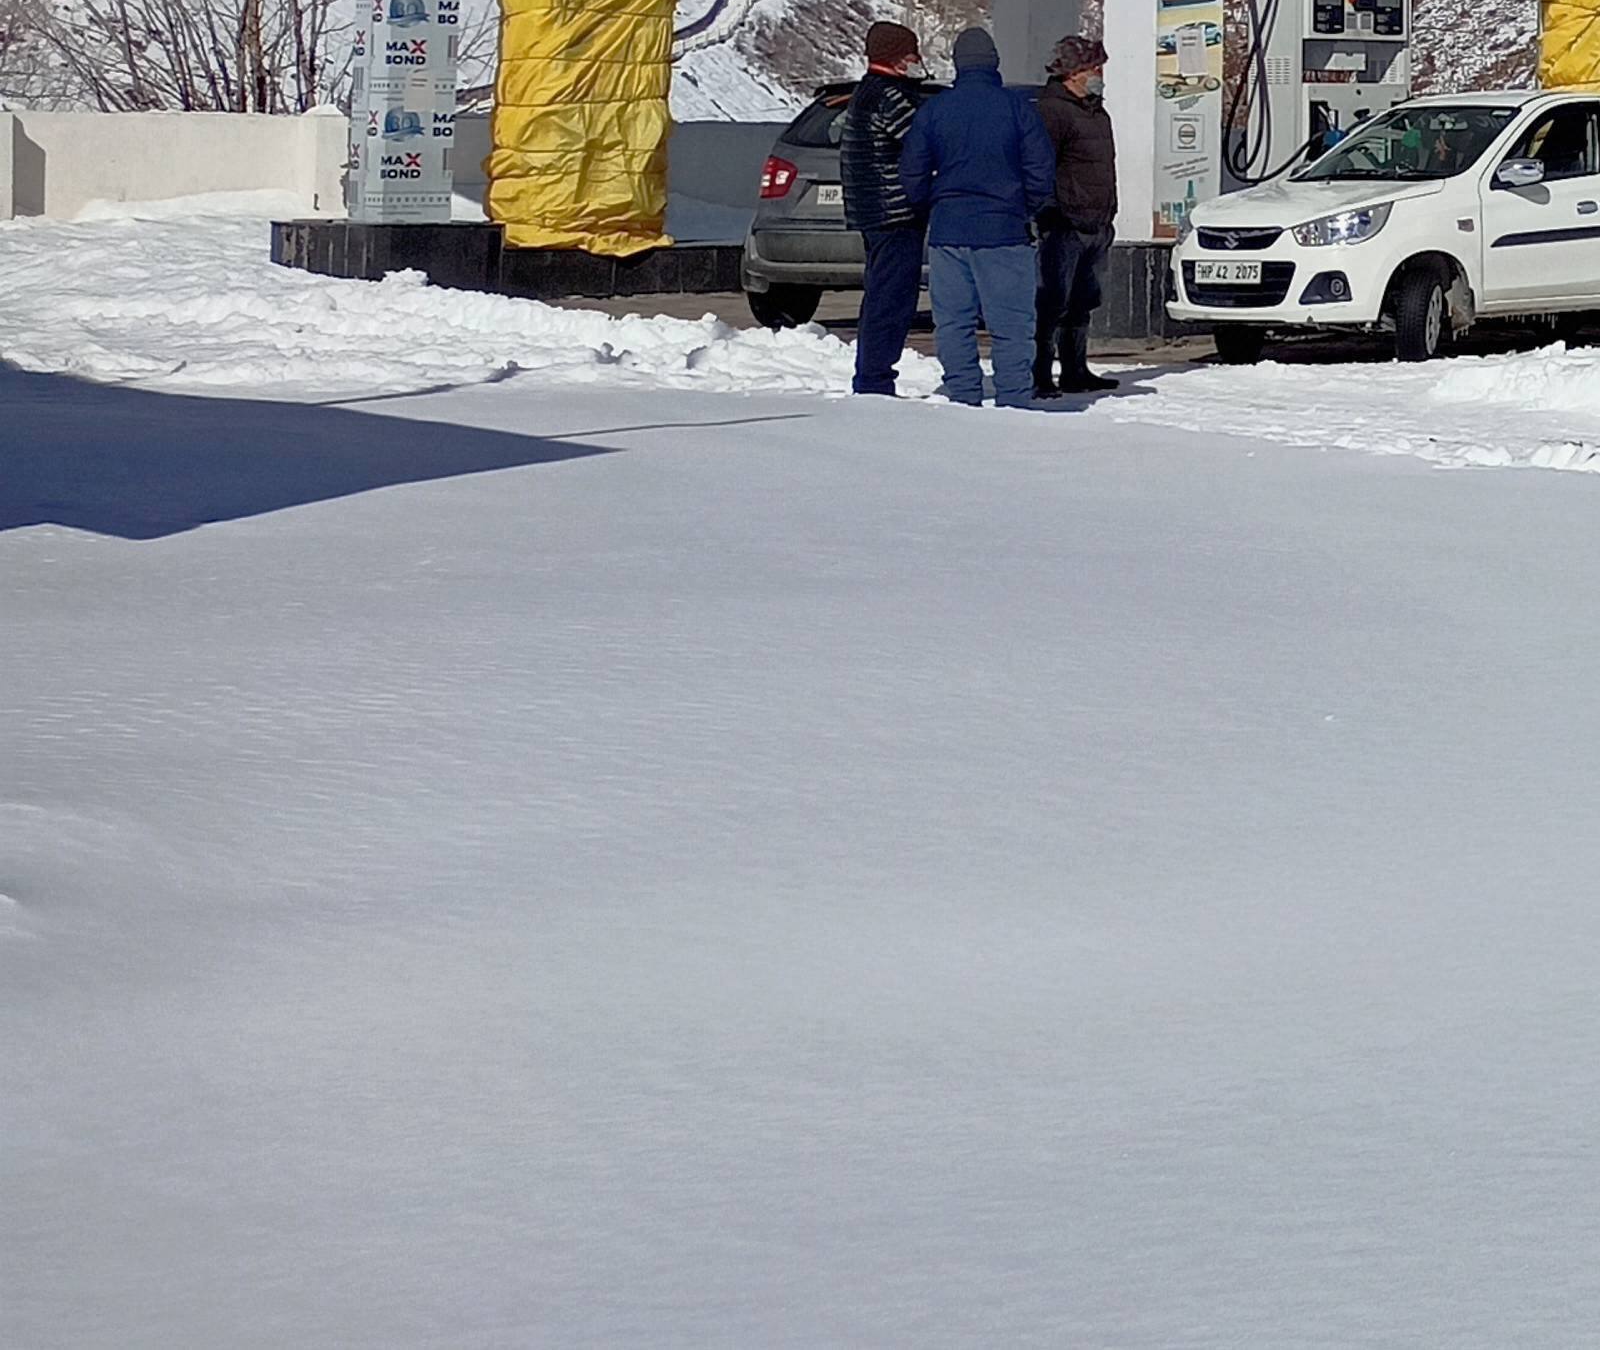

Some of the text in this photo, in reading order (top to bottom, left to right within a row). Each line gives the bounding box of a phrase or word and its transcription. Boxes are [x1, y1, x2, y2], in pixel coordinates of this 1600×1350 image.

[386, 40, 427, 55] MAX
[385, 55, 426, 66] BOND
[381, 153, 422, 168] MAX
[380, 168, 421, 179] BOND
